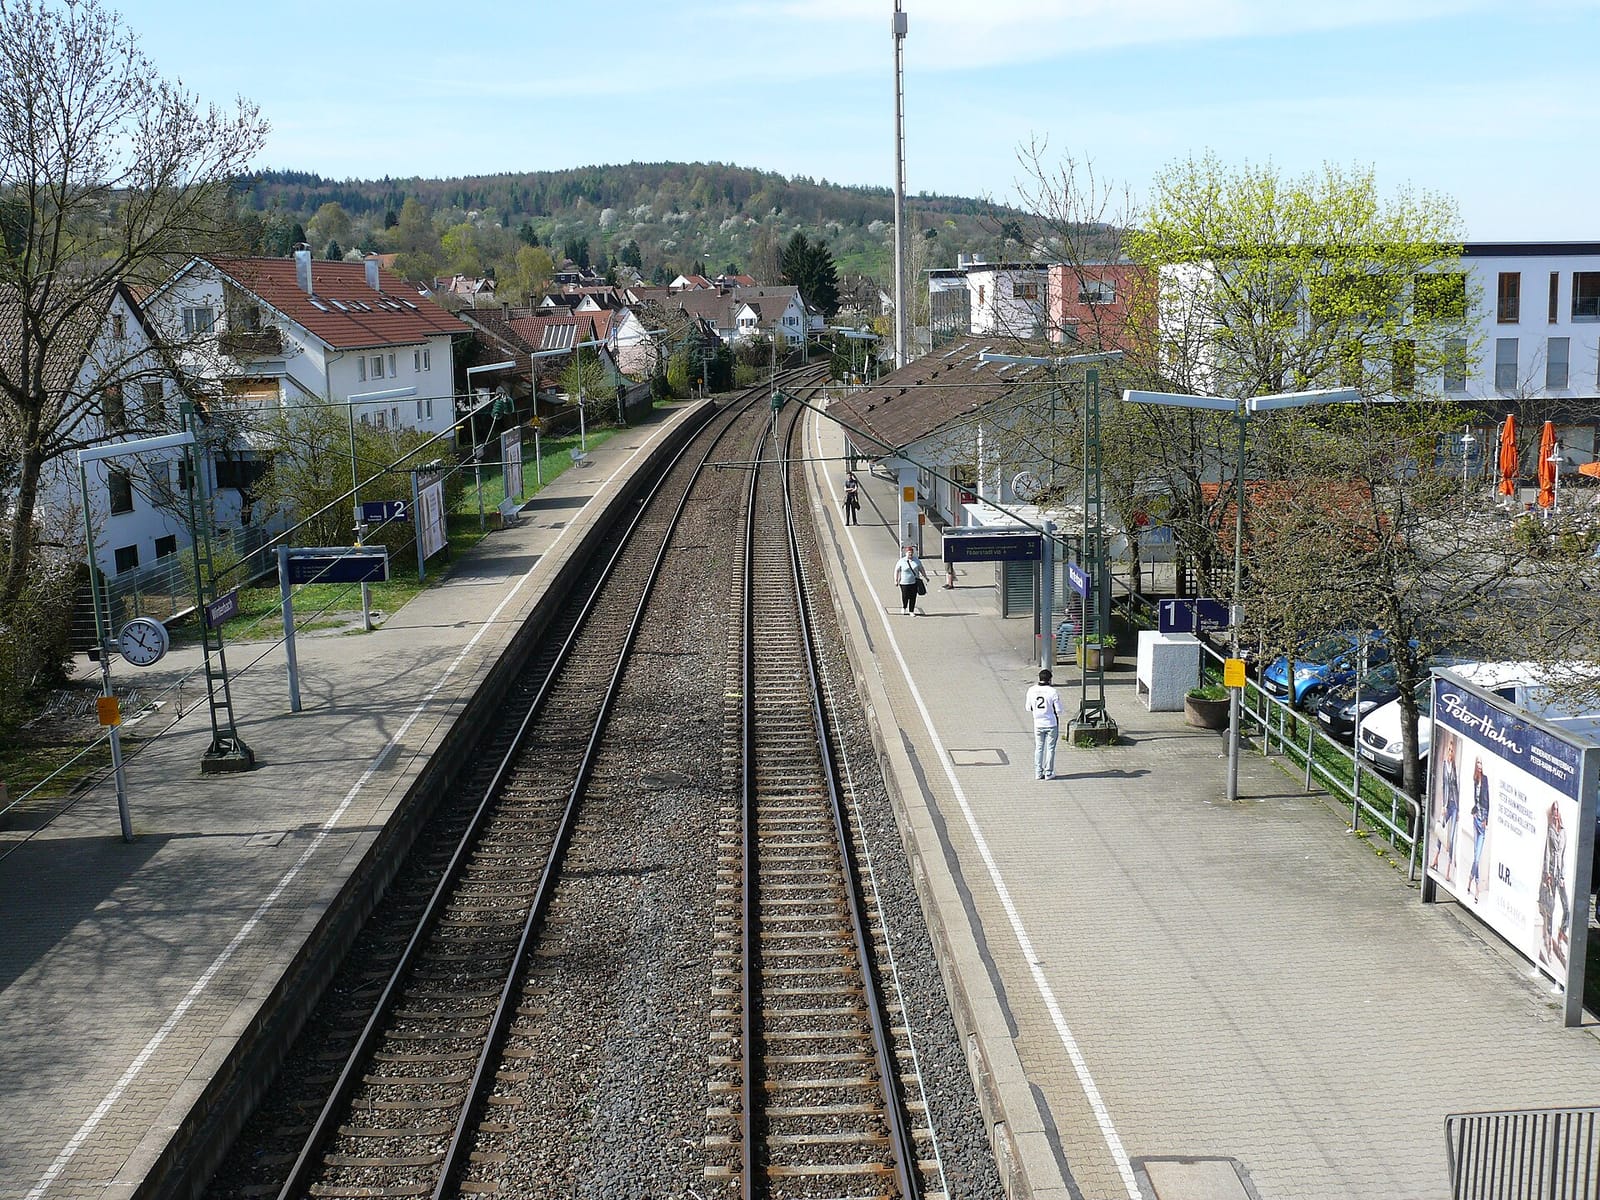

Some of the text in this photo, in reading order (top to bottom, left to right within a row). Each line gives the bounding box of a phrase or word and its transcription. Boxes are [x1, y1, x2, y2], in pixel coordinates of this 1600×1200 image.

[393, 501, 405, 517] 2
[1164, 601, 1175, 626] 1
[1036, 696, 1046, 709] 2
[1441, 693, 1523, 754] Peter Hahn
